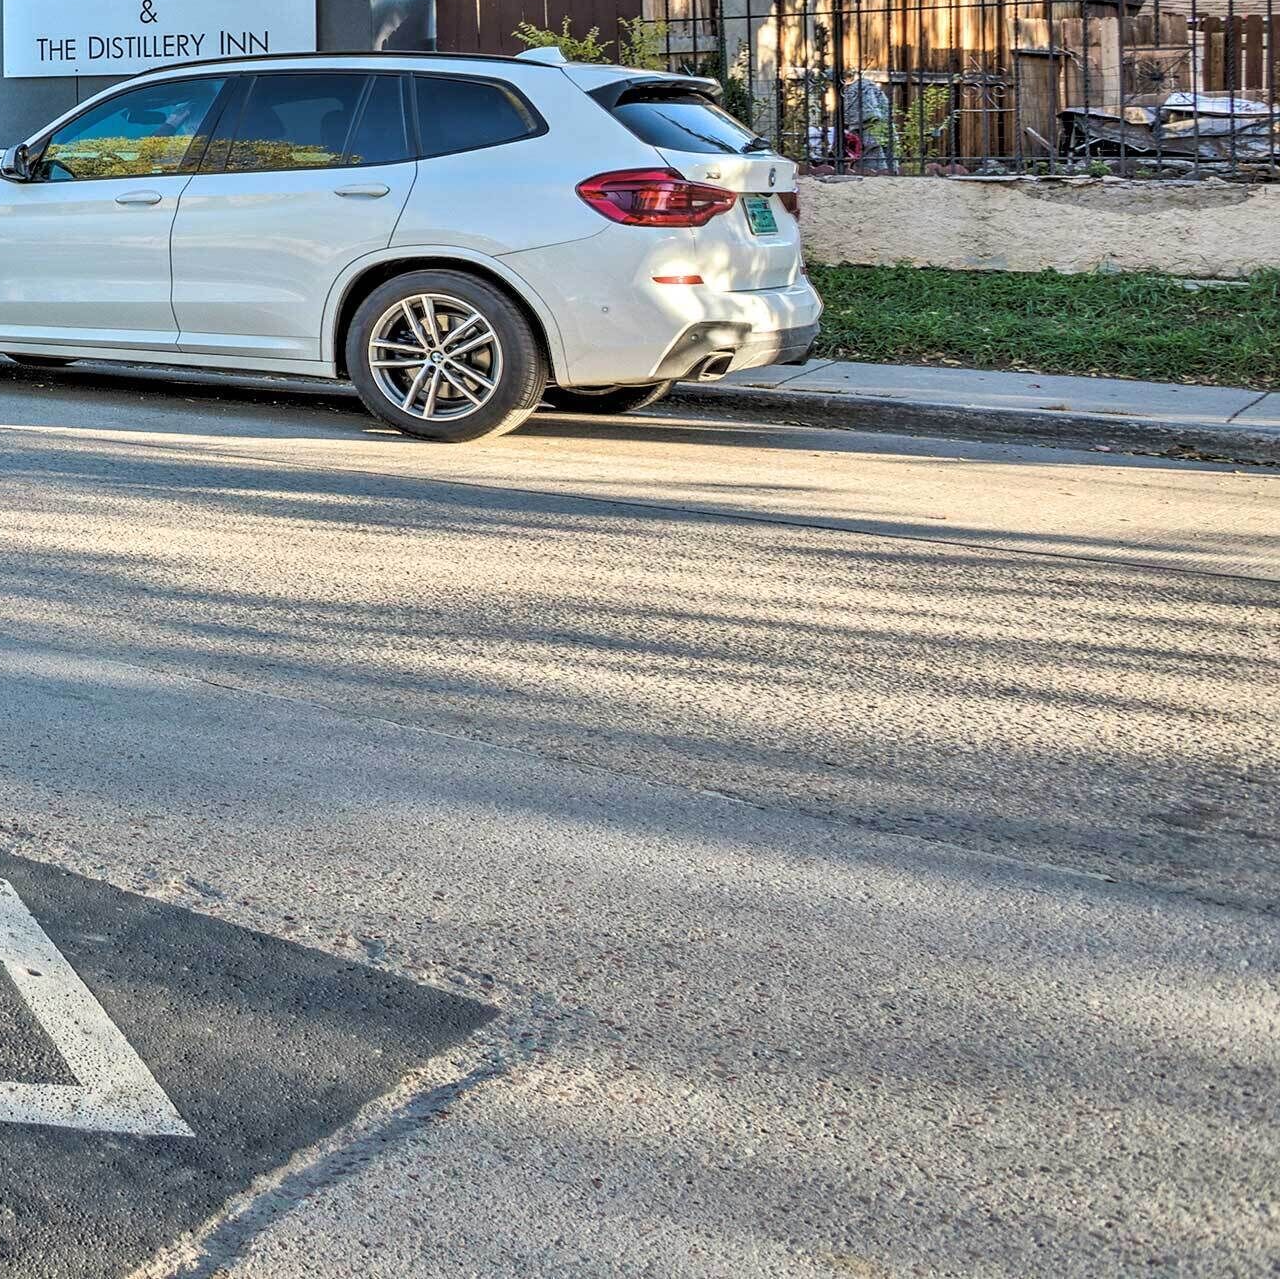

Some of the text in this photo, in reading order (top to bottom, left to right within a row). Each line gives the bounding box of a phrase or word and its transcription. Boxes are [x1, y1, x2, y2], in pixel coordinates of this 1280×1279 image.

[139, 0, 158, 24] &
[36, 30, 269, 61] THE DISTILLERY INN
